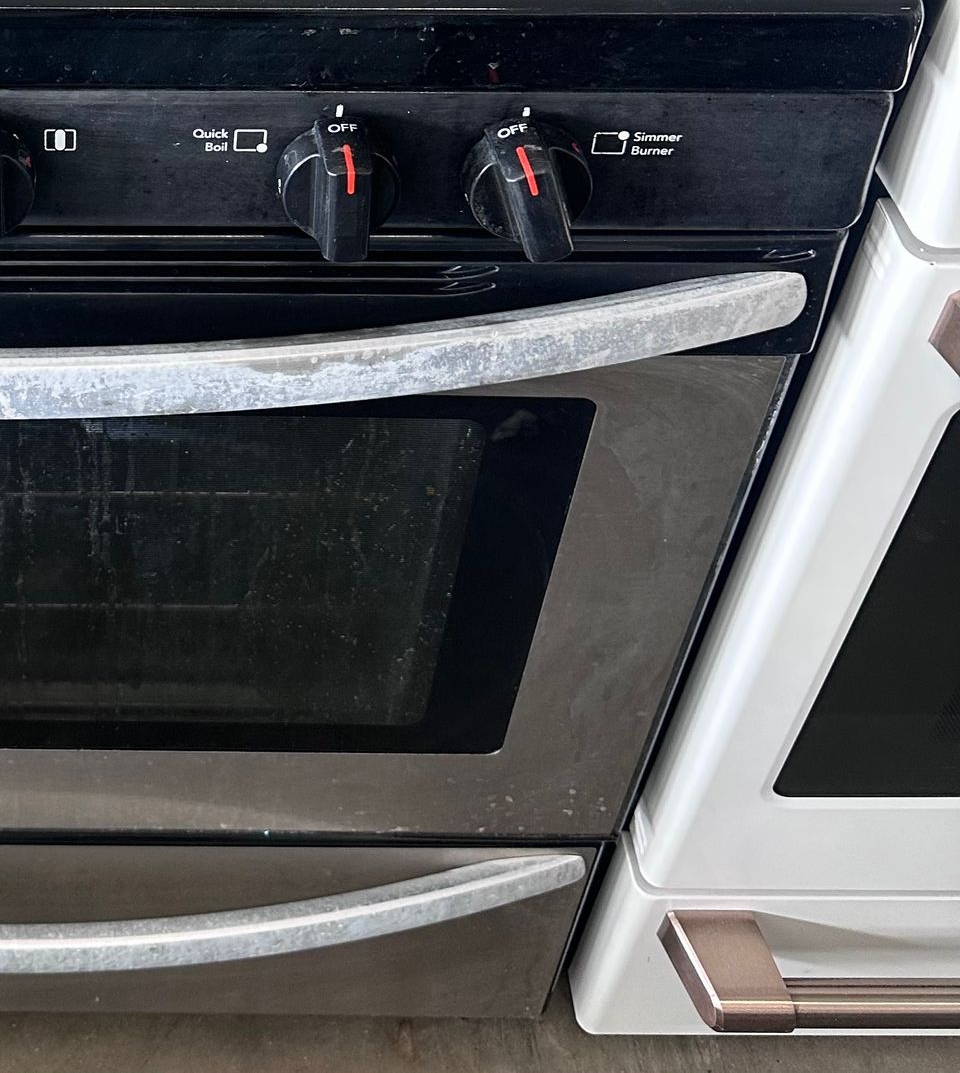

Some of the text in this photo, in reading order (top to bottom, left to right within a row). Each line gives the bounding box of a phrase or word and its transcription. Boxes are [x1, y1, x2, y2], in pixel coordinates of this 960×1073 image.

[192, 128, 229, 139] Quick
[327, 124, 358, 133] OFF
[497, 123, 529, 139] OFF
[633, 131, 683, 143] Simmer
[205, 142, 228, 152] Boil
[631, 146, 674, 156] Burner
